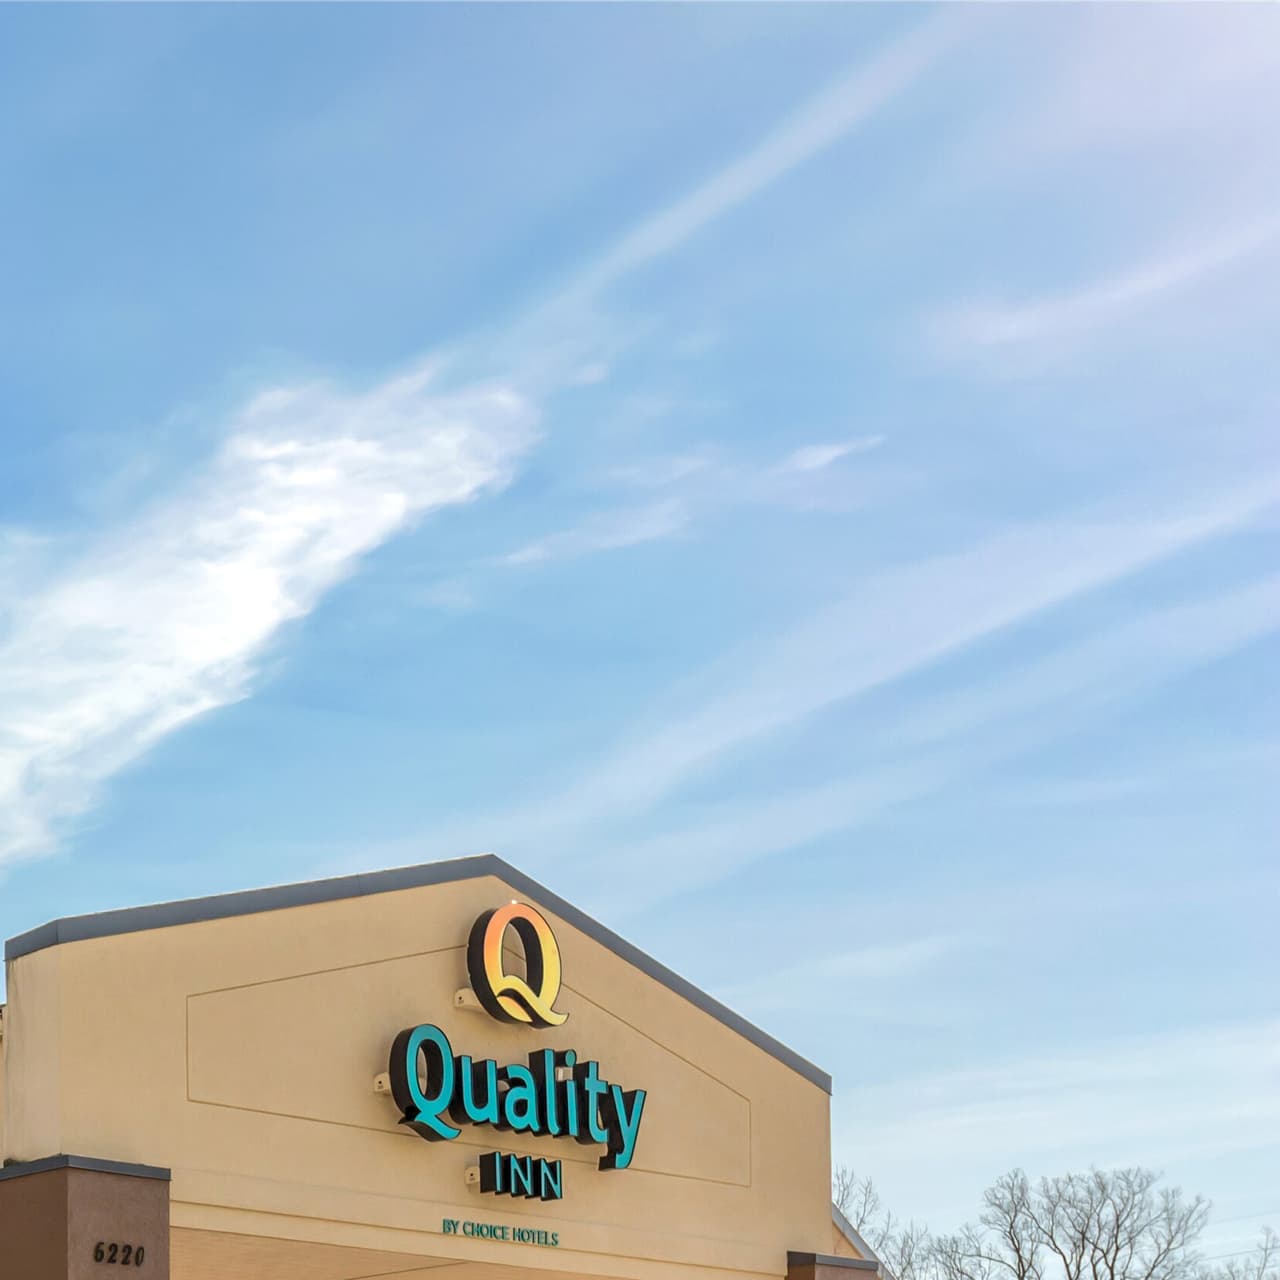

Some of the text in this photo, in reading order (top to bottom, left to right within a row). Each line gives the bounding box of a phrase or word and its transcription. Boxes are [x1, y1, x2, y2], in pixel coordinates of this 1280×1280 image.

[470, 902, 569, 1027] Q
[392, 1023, 647, 1170] Quality
[483, 1151, 562, 1200] INN
[93, 1241, 145, 1267] 6220
[442, 1218, 559, 1246] BY CHOICE HOTELS
